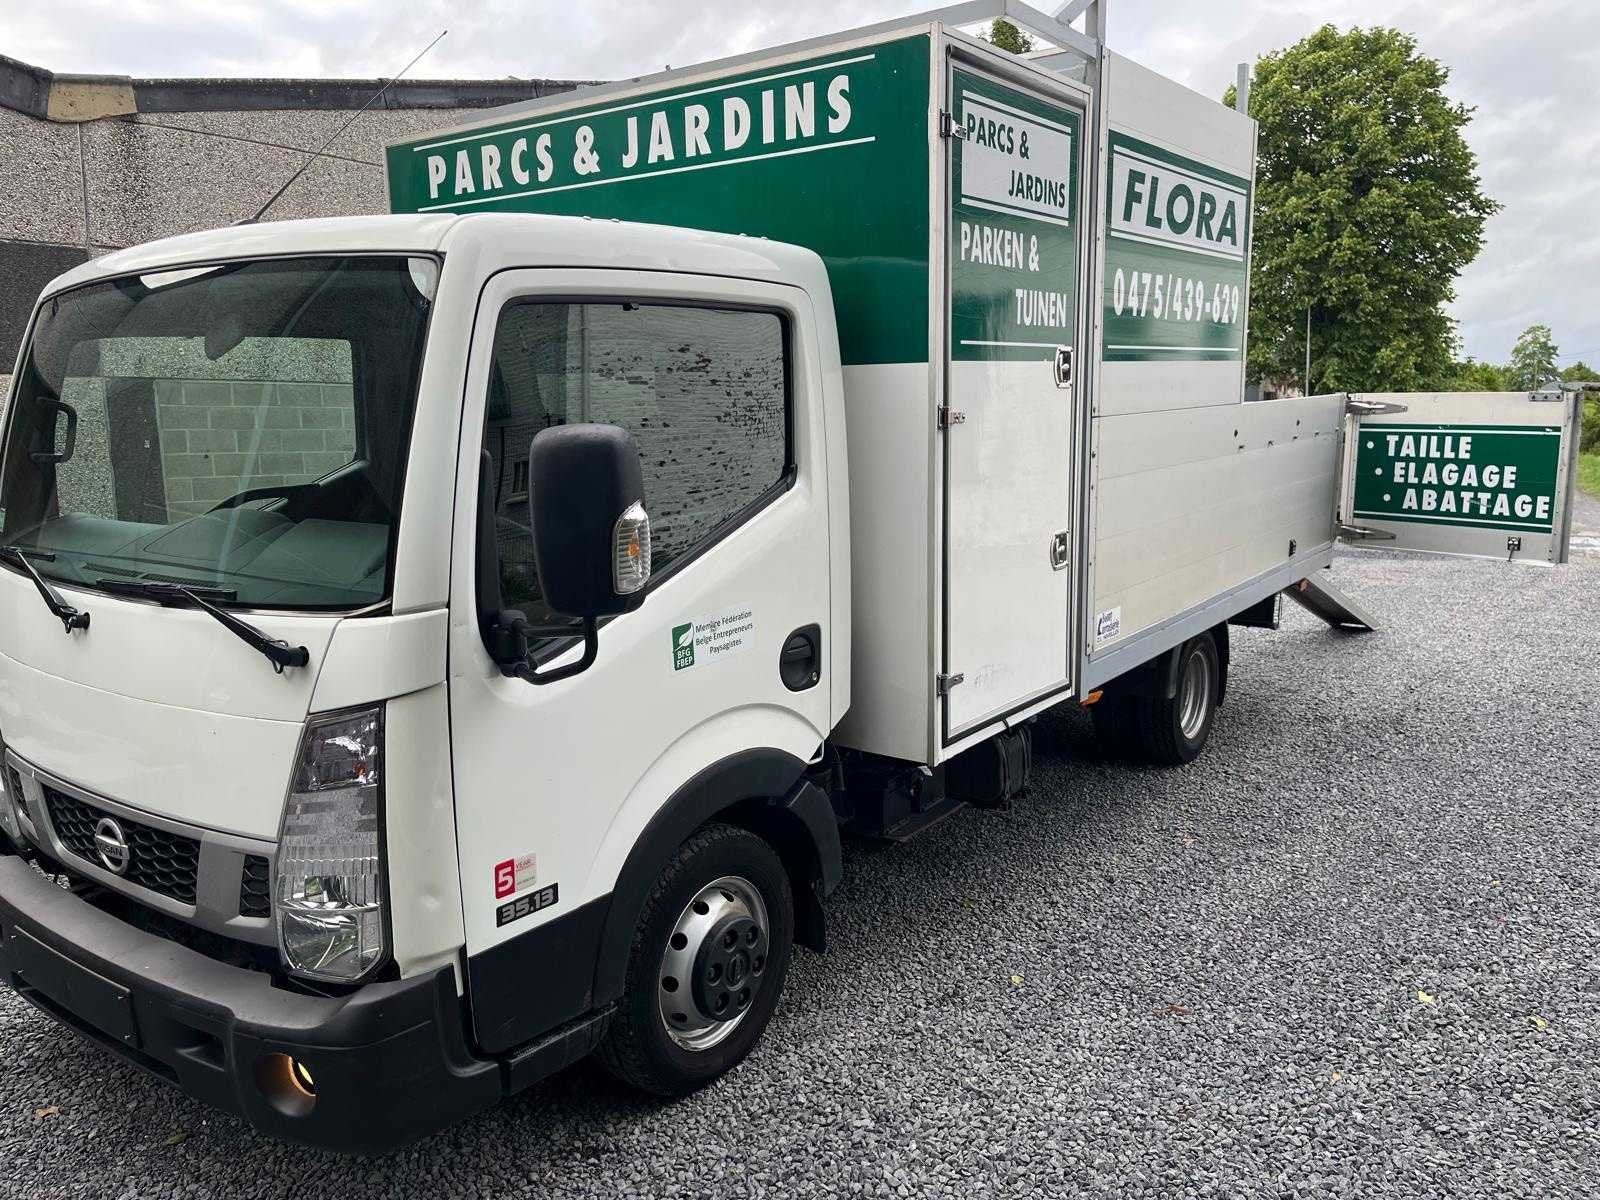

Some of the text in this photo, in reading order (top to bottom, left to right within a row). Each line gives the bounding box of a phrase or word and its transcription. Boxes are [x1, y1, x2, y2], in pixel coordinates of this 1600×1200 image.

[427, 74, 853, 199] PARCS & JARDINS
[966, 112, 1030, 160] PARCS &
[1008, 169, 1066, 209] JARDINS
[1122, 168, 1238, 247] FLORA
[961, 222, 1040, 272] PARKEN &
[1015, 288, 1067, 328] TUINEN
[1113, 267, 1240, 325] 0475/439-629
[1386, 434, 1472, 460] TAILLE
[1393, 461, 1517, 489] ELAGAGE
[1402, 488, 1550, 520] ABATTAGE
[709, 638, 742, 655] Paysagistes
[713, 622, 753, 641] Entrepreneurs
[676, 657, 694, 670] FBEP
[677, 647, 691, 660] BFG
[497, 866, 514, 893] 5
[501, 887, 554, 923] 35.13
